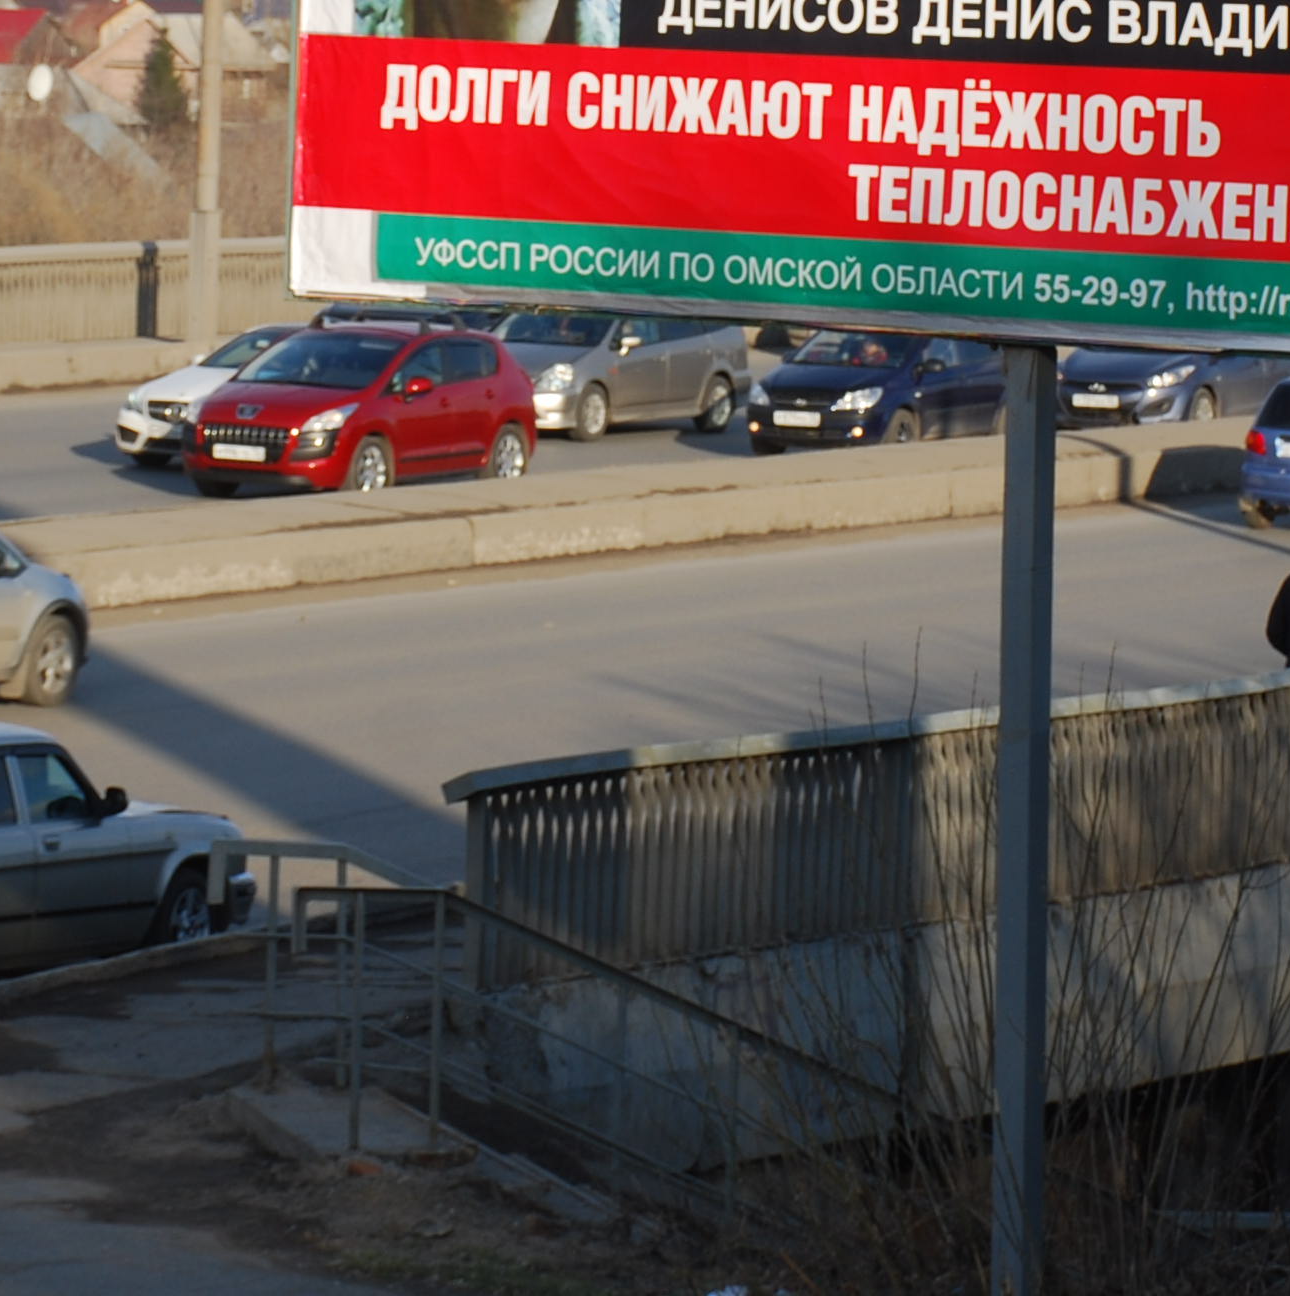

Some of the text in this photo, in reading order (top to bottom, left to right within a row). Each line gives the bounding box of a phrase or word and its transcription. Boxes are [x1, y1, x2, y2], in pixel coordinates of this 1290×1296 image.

[380, 63, 1222, 158] ДОЛГИ СНИЖАЮТ НАДЁЖНОСТЬ
[414, 237, 521, 272] УФССП
[529, 241, 661, 279] РОССИИ
[669, 252, 715, 282] ПО
[723, 254, 862, 292] ОМСКОЙ
[872, 264, 1024, 300] ОБЛАСТИ
[1034, 273, 1175, 314] 55-29-97,
